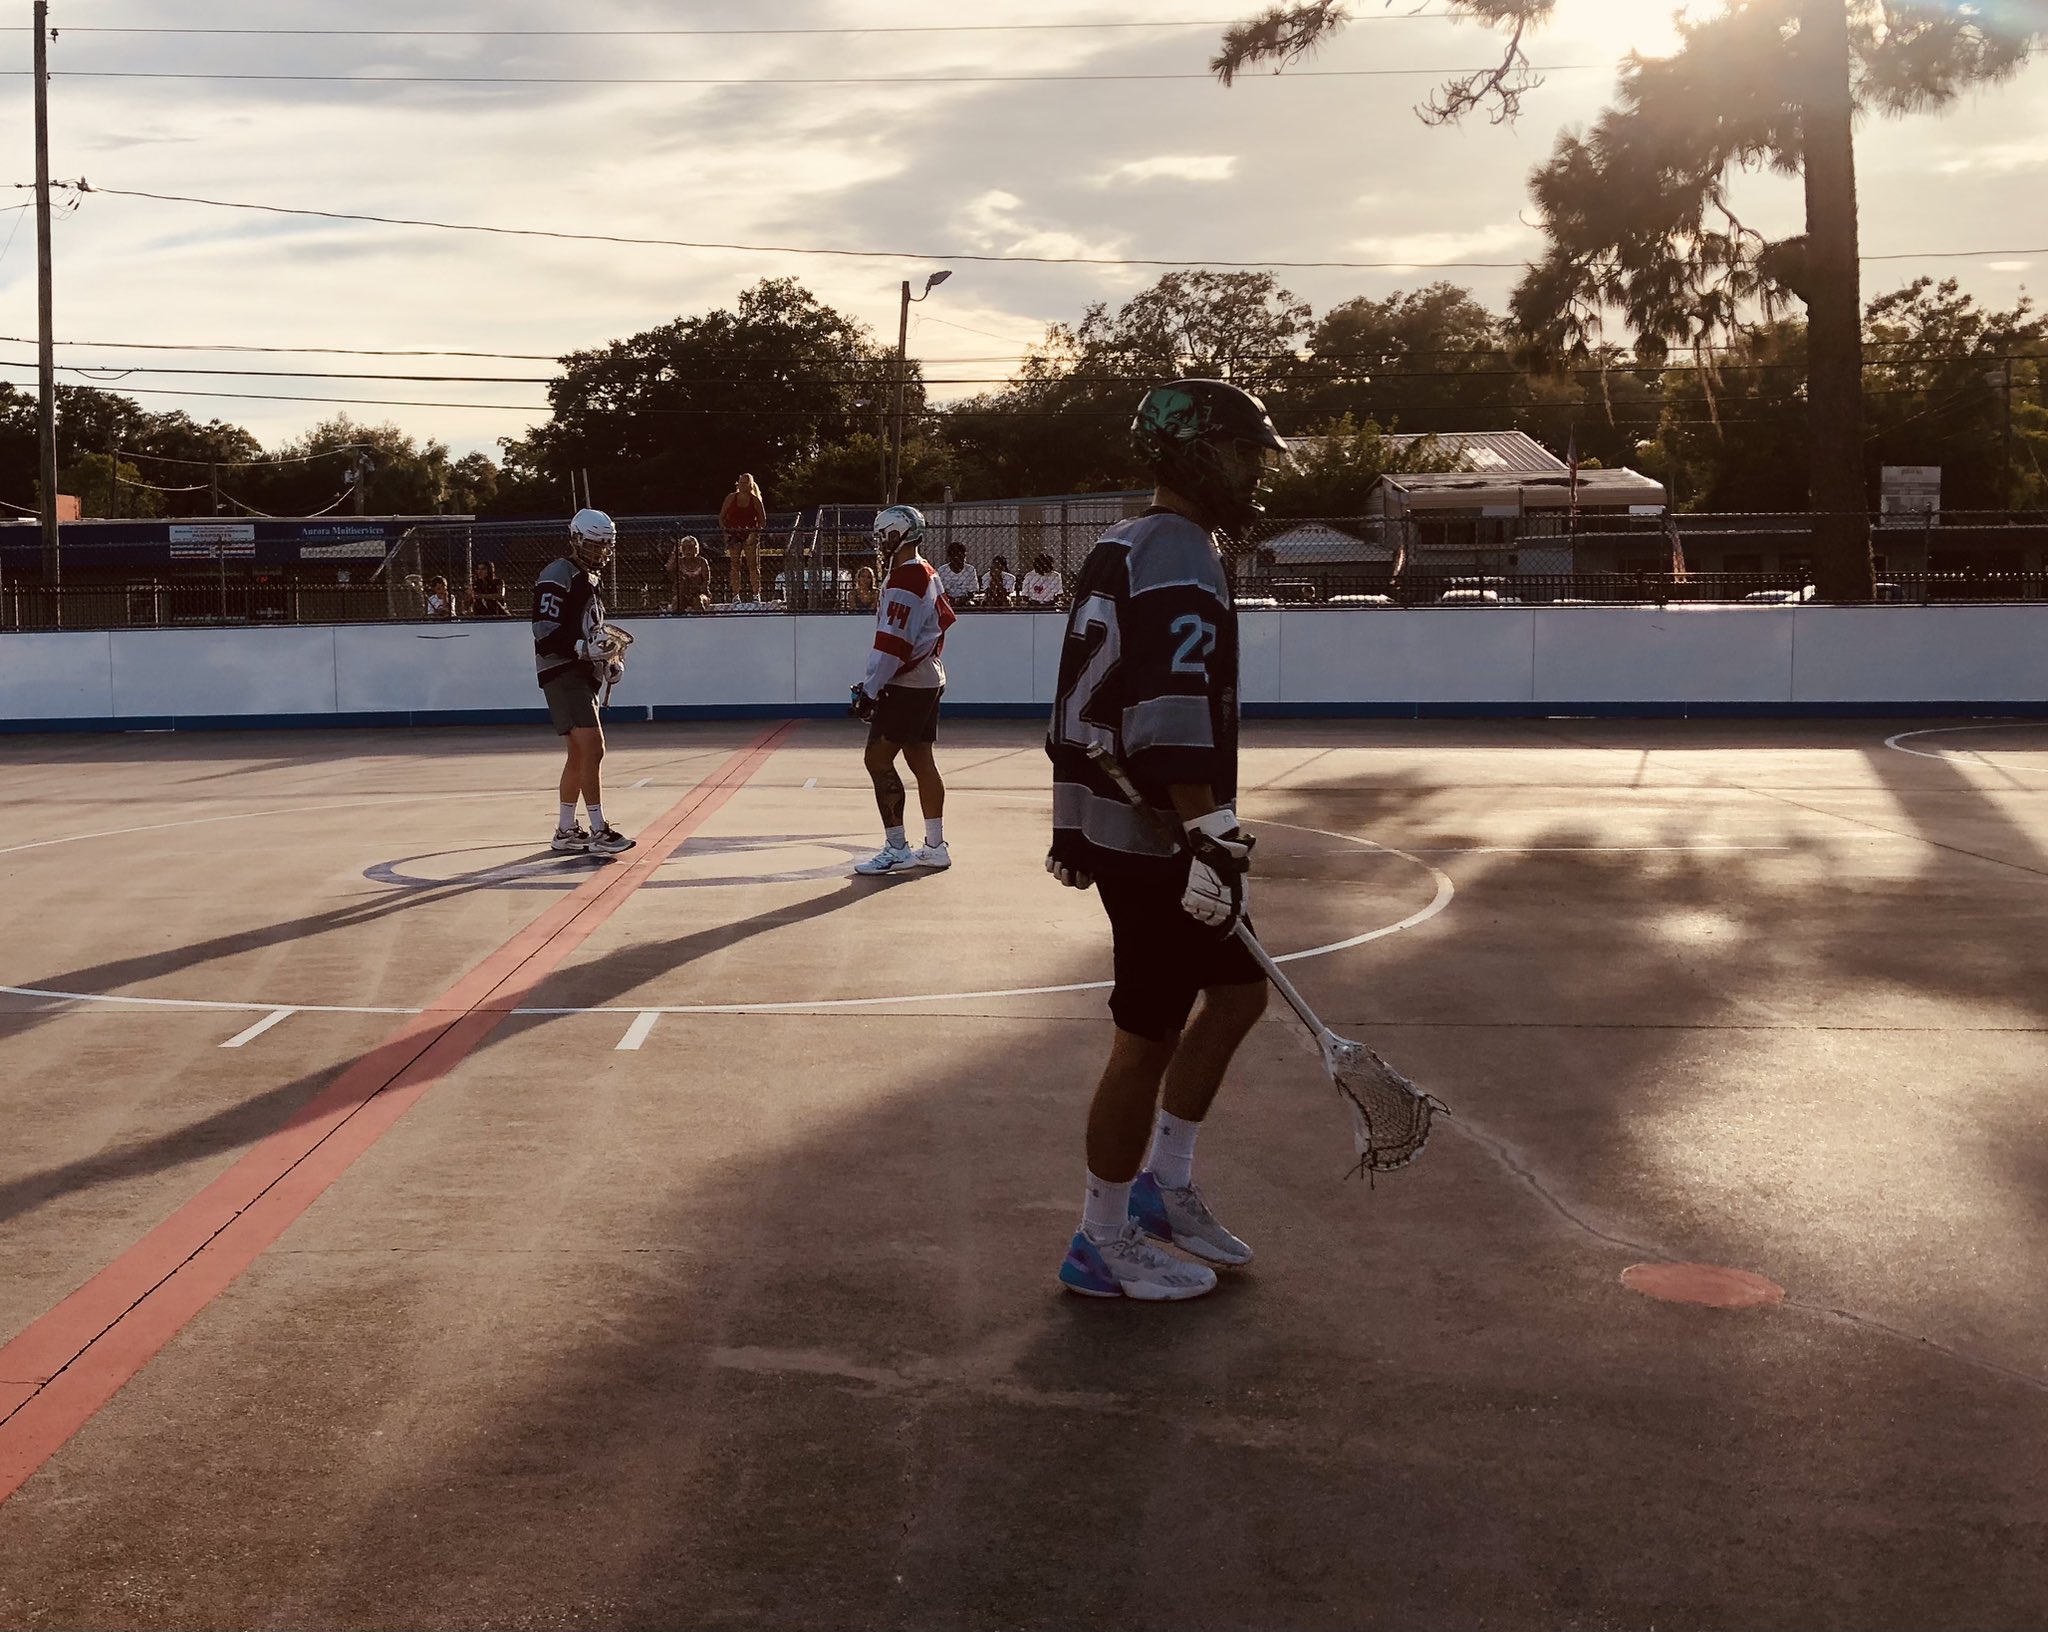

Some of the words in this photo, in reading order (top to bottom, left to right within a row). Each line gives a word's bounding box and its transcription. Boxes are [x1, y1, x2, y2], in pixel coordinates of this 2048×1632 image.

[302, 527, 330, 535] Aurora
[332, 526, 385, 535] Multiservices
[539, 592, 564, 618] 55
[887, 600, 912, 630] 44
